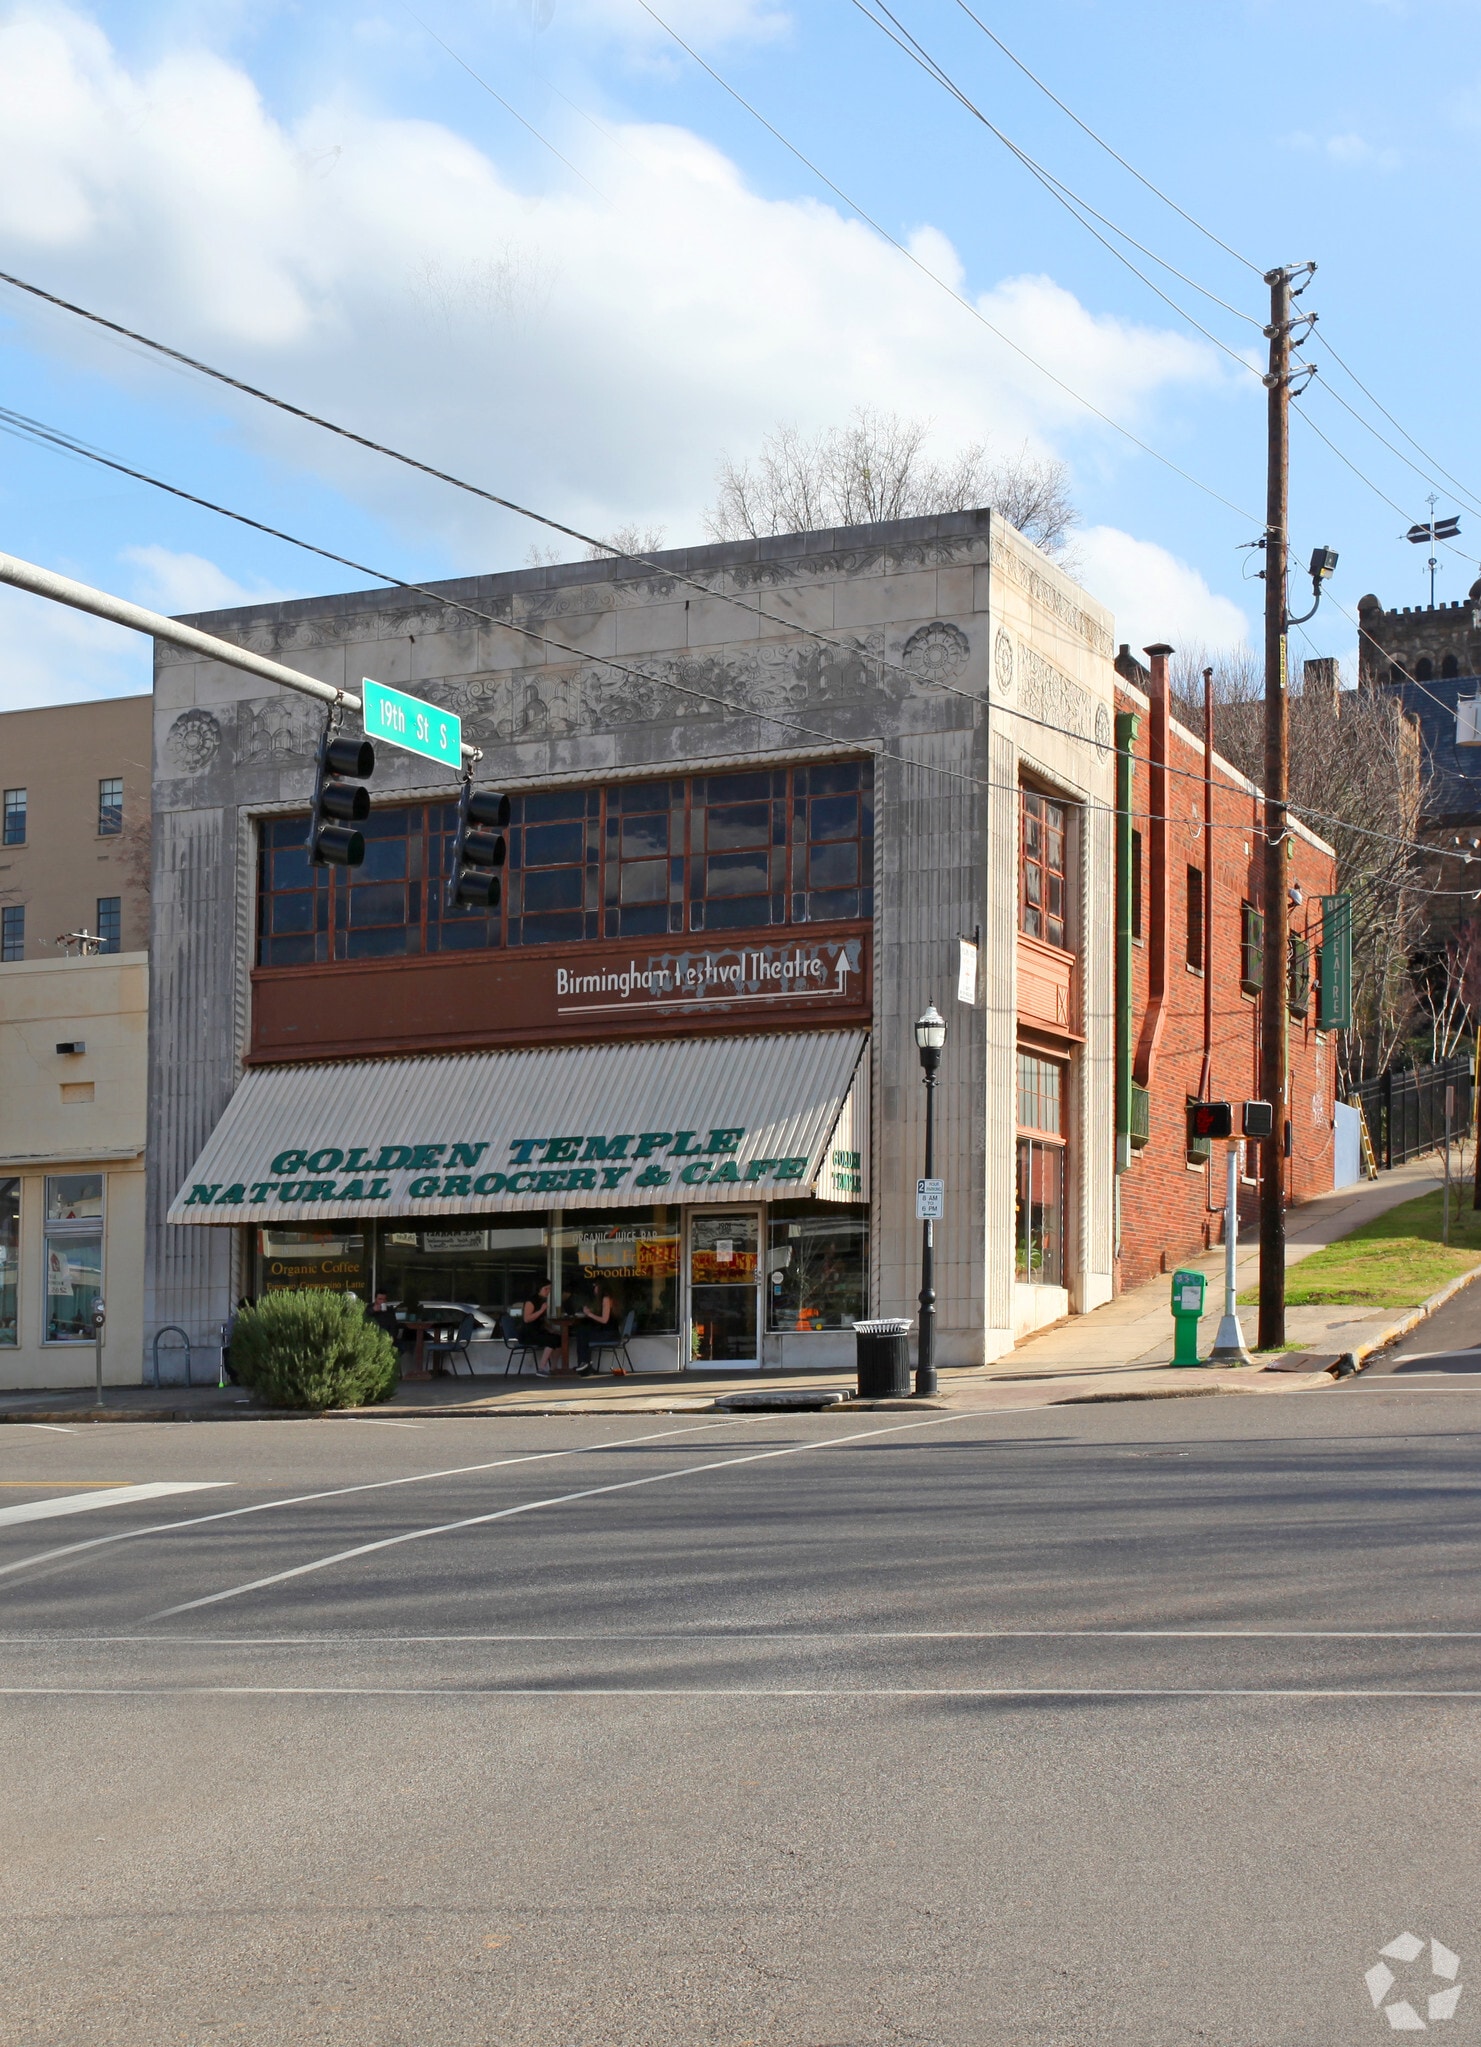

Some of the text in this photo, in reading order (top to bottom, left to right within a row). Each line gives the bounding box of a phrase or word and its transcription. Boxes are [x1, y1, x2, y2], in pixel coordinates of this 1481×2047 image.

[380, 699, 447, 750] 19th St S
[751, 949, 821, 981] Theatre
[270, 1127, 745, 1175] GOLDEN TEMPLE
[184, 1157, 809, 1205] NATURAL GROCERY & CAFE
[832, 1172, 861, 1193] TEMPLE
[918, 1182, 924, 1192] 2
[573, 1230, 659, 1245] ORGANIC JUICE BAR
[271, 1260, 360, 1277] Organic Coffee
[584, 1265, 648, 1279] Smoothies
[345, 1280, 365, 1289] Latte
